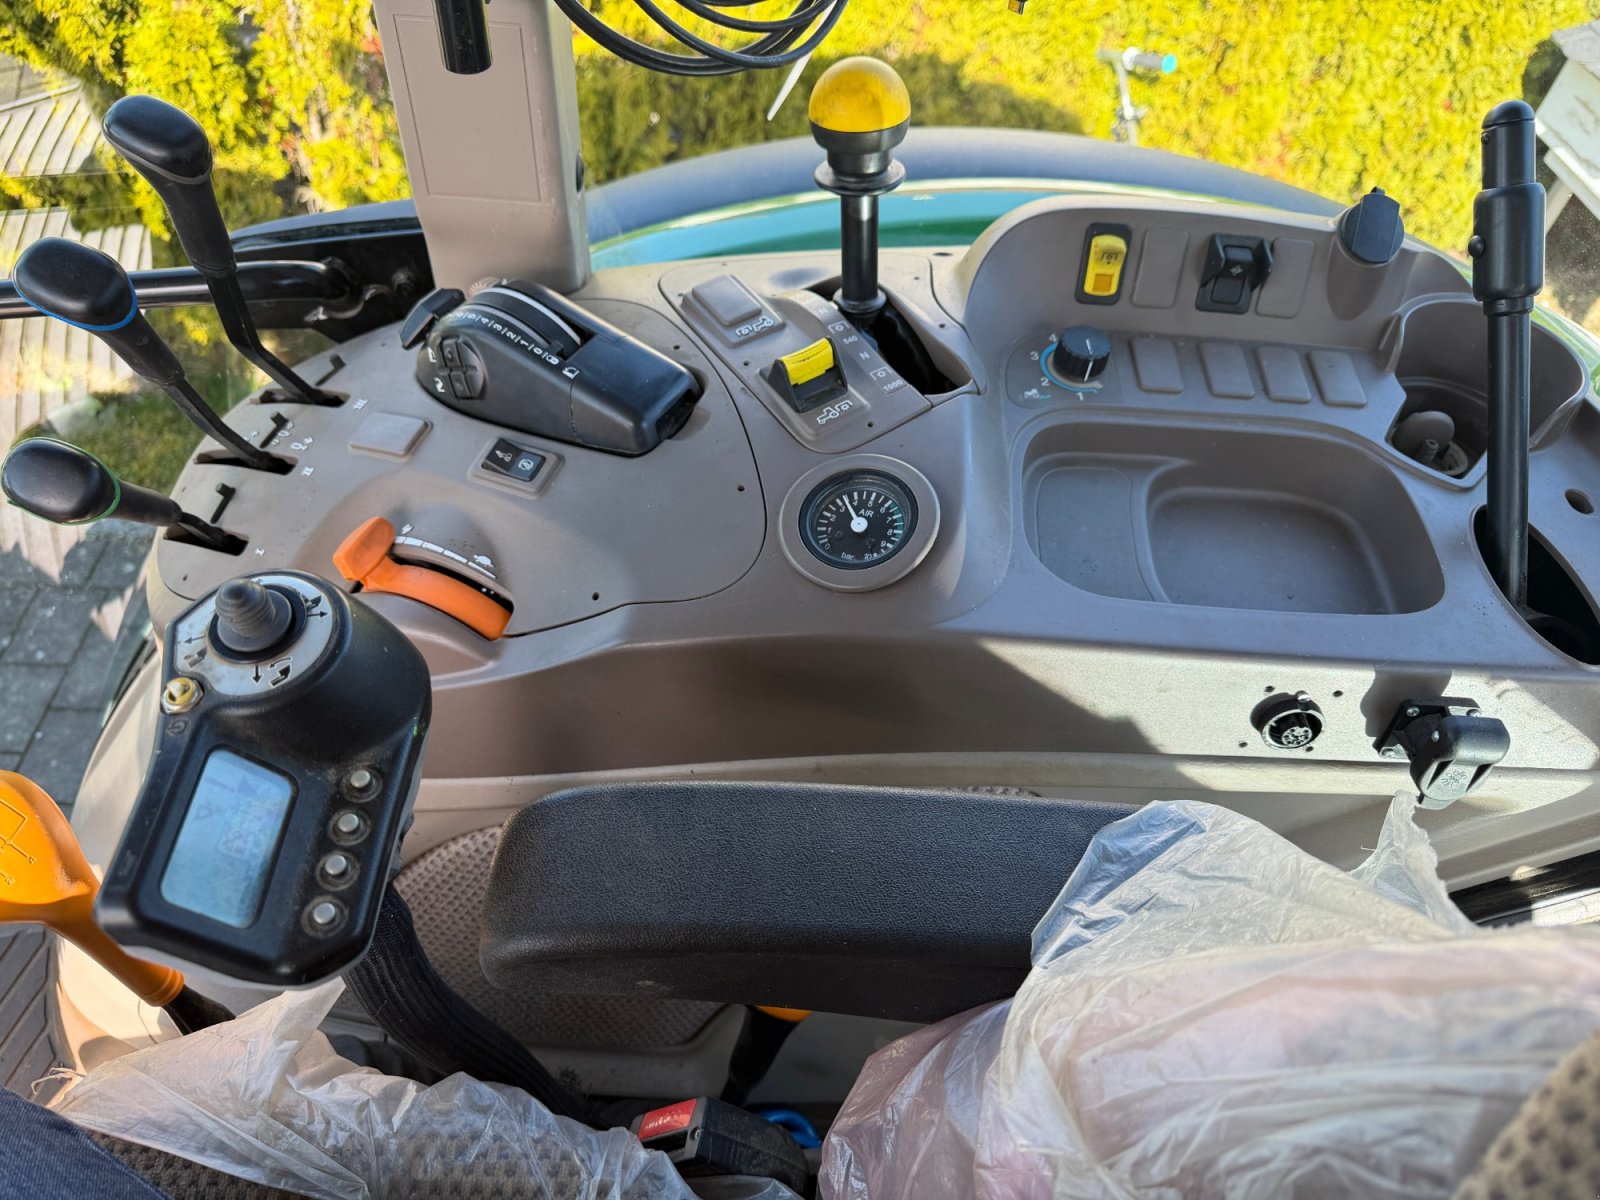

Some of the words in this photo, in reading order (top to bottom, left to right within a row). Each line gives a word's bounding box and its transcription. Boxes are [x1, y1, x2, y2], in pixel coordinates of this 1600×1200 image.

[493, 323, 503, 331] 3
[506, 331, 515, 340] 2
[843, 335, 858, 344] 540
[1049, 334, 1057, 342] 4
[859, 351, 870, 360] N
[1030, 351, 1039, 361] 3
[883, 379, 903, 392] 1000
[1041, 377, 1050, 387] 2
[1077, 392, 1084, 401] 1
[839, 505, 846, 513] 3
[859, 509, 875, 517] AIR
[879, 506, 886, 514] 6
[864, 553, 874, 561] 10
